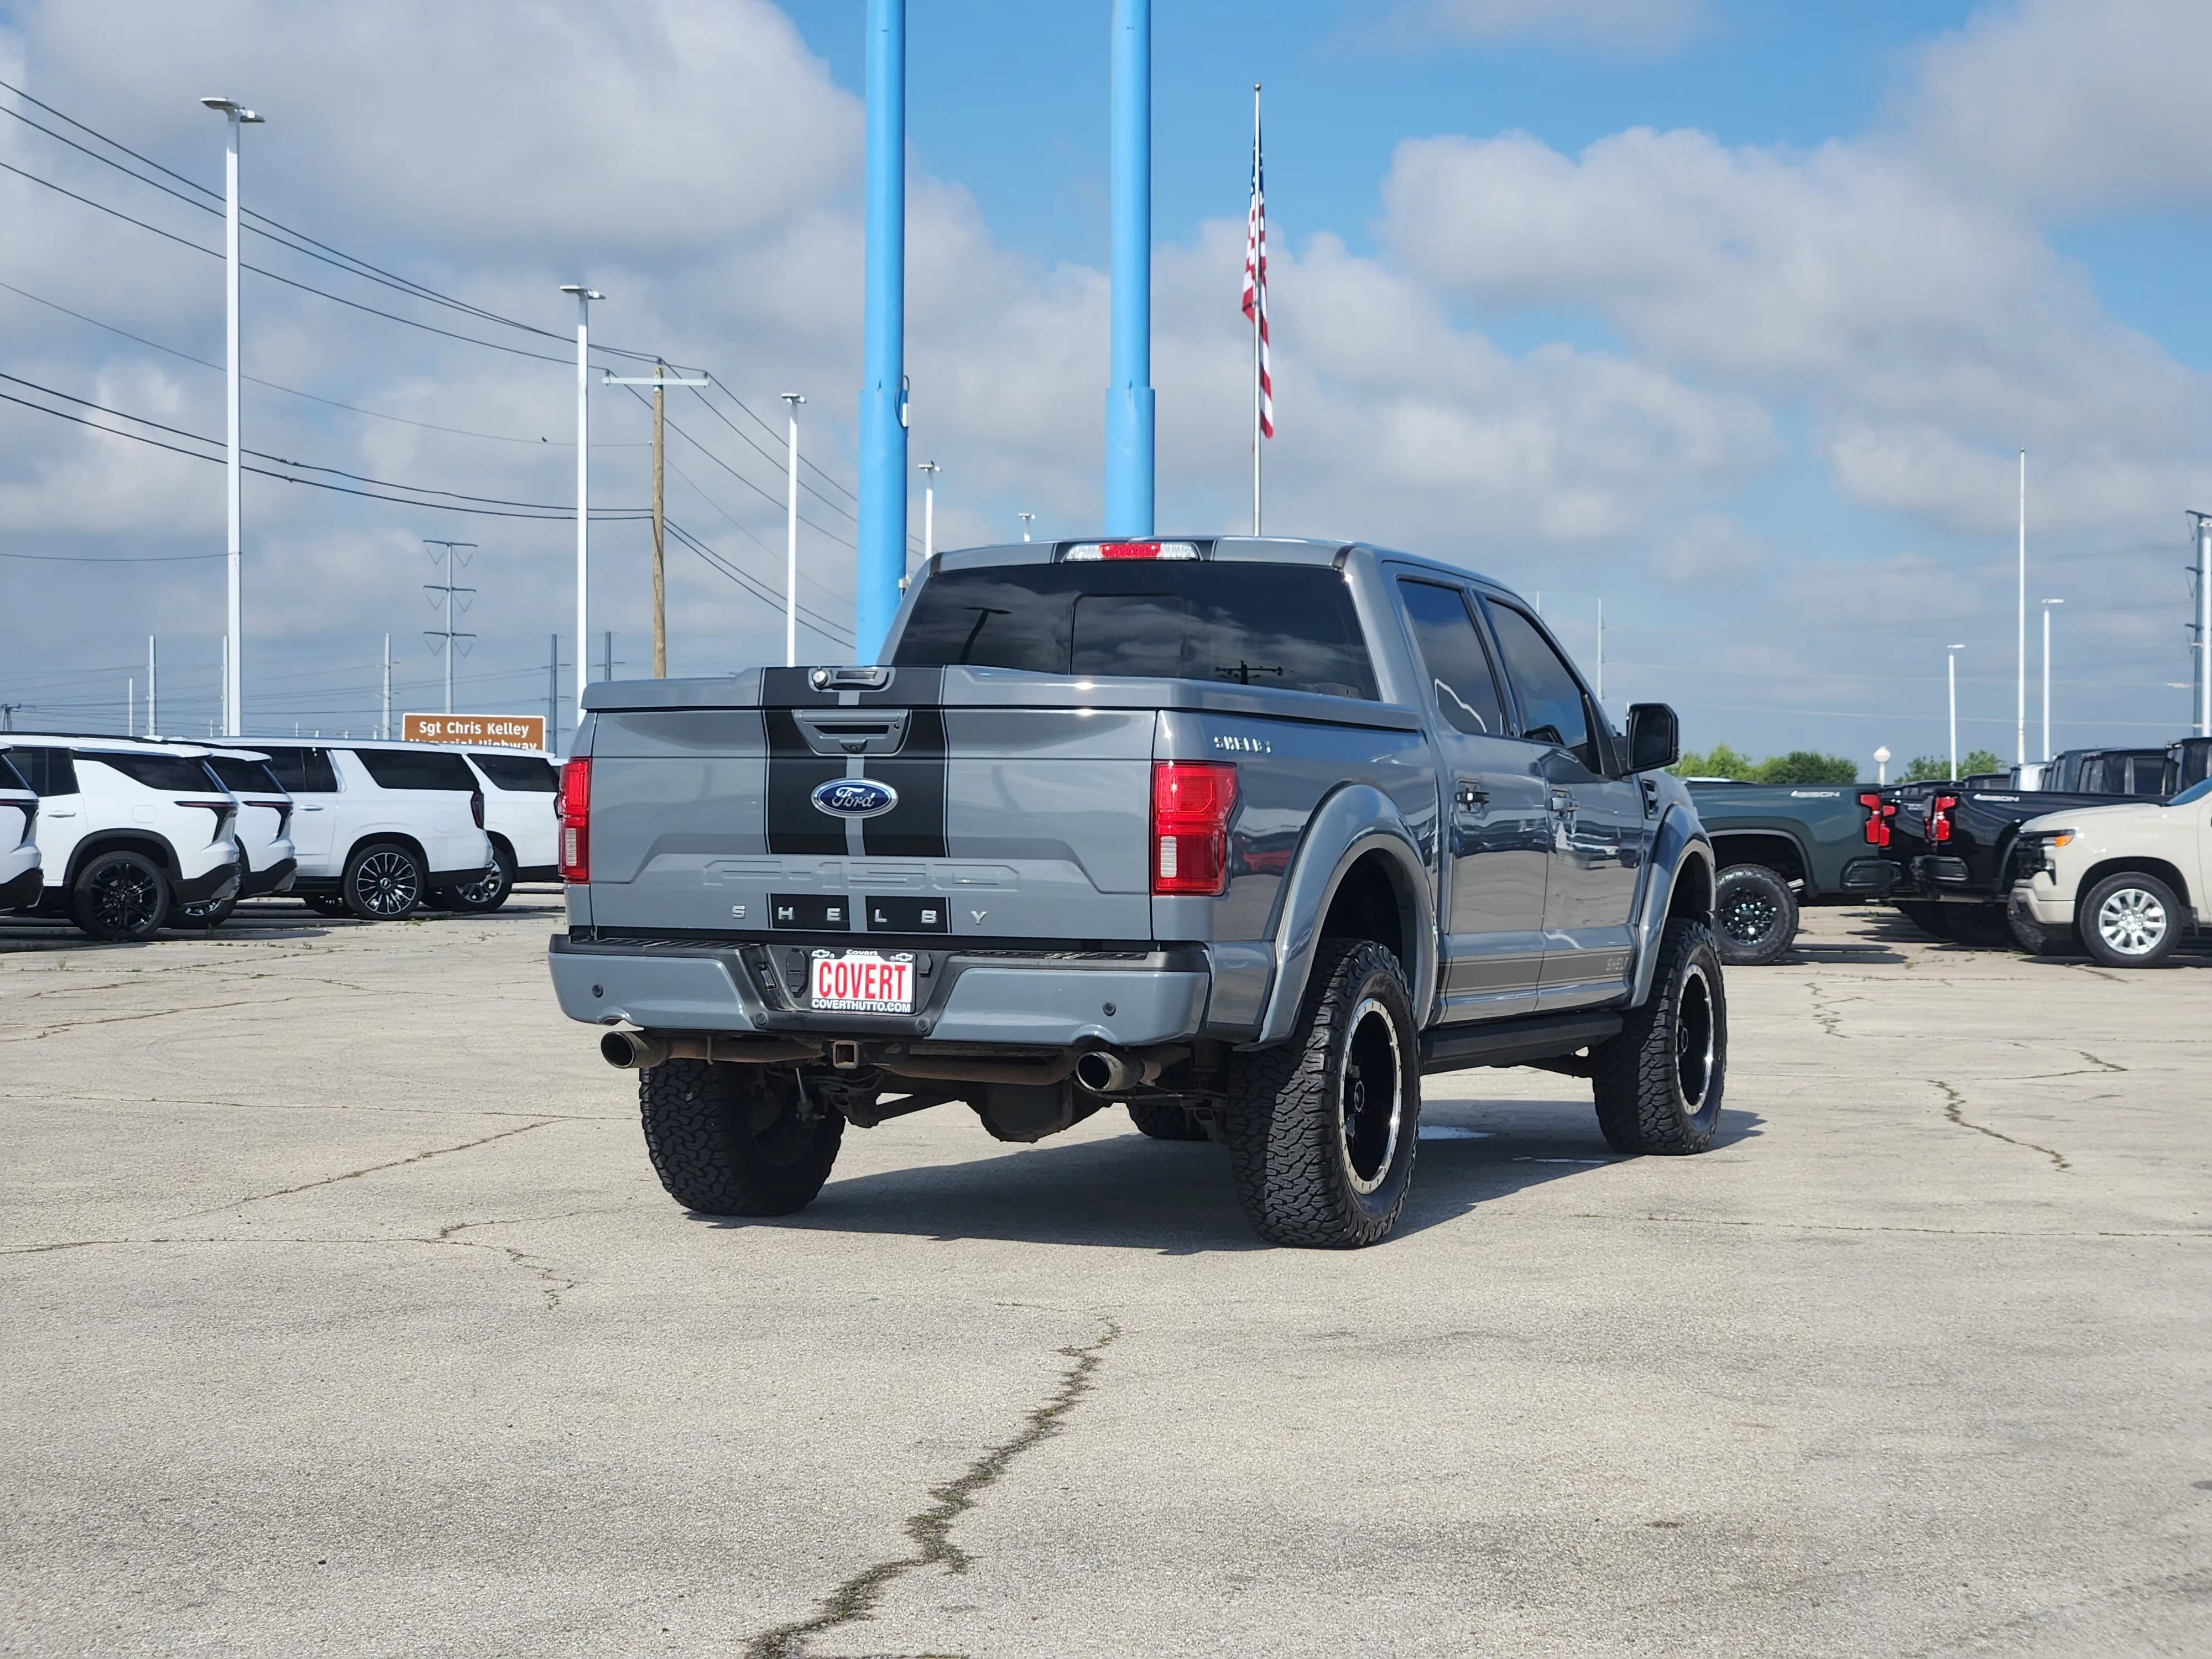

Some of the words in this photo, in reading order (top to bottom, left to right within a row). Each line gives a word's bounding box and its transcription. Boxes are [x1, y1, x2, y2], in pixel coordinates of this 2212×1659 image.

[419, 721, 441, 736] Sgt
[446, 722, 482, 734] Chris
[487, 722, 529, 738] Kelley
[831, 786, 876, 807] Ford
[732, 905, 988, 925] SHELBY
[819, 961, 907, 1000] COVERT
[811, 999, 911, 1013] COVERTHUTTO.COM
